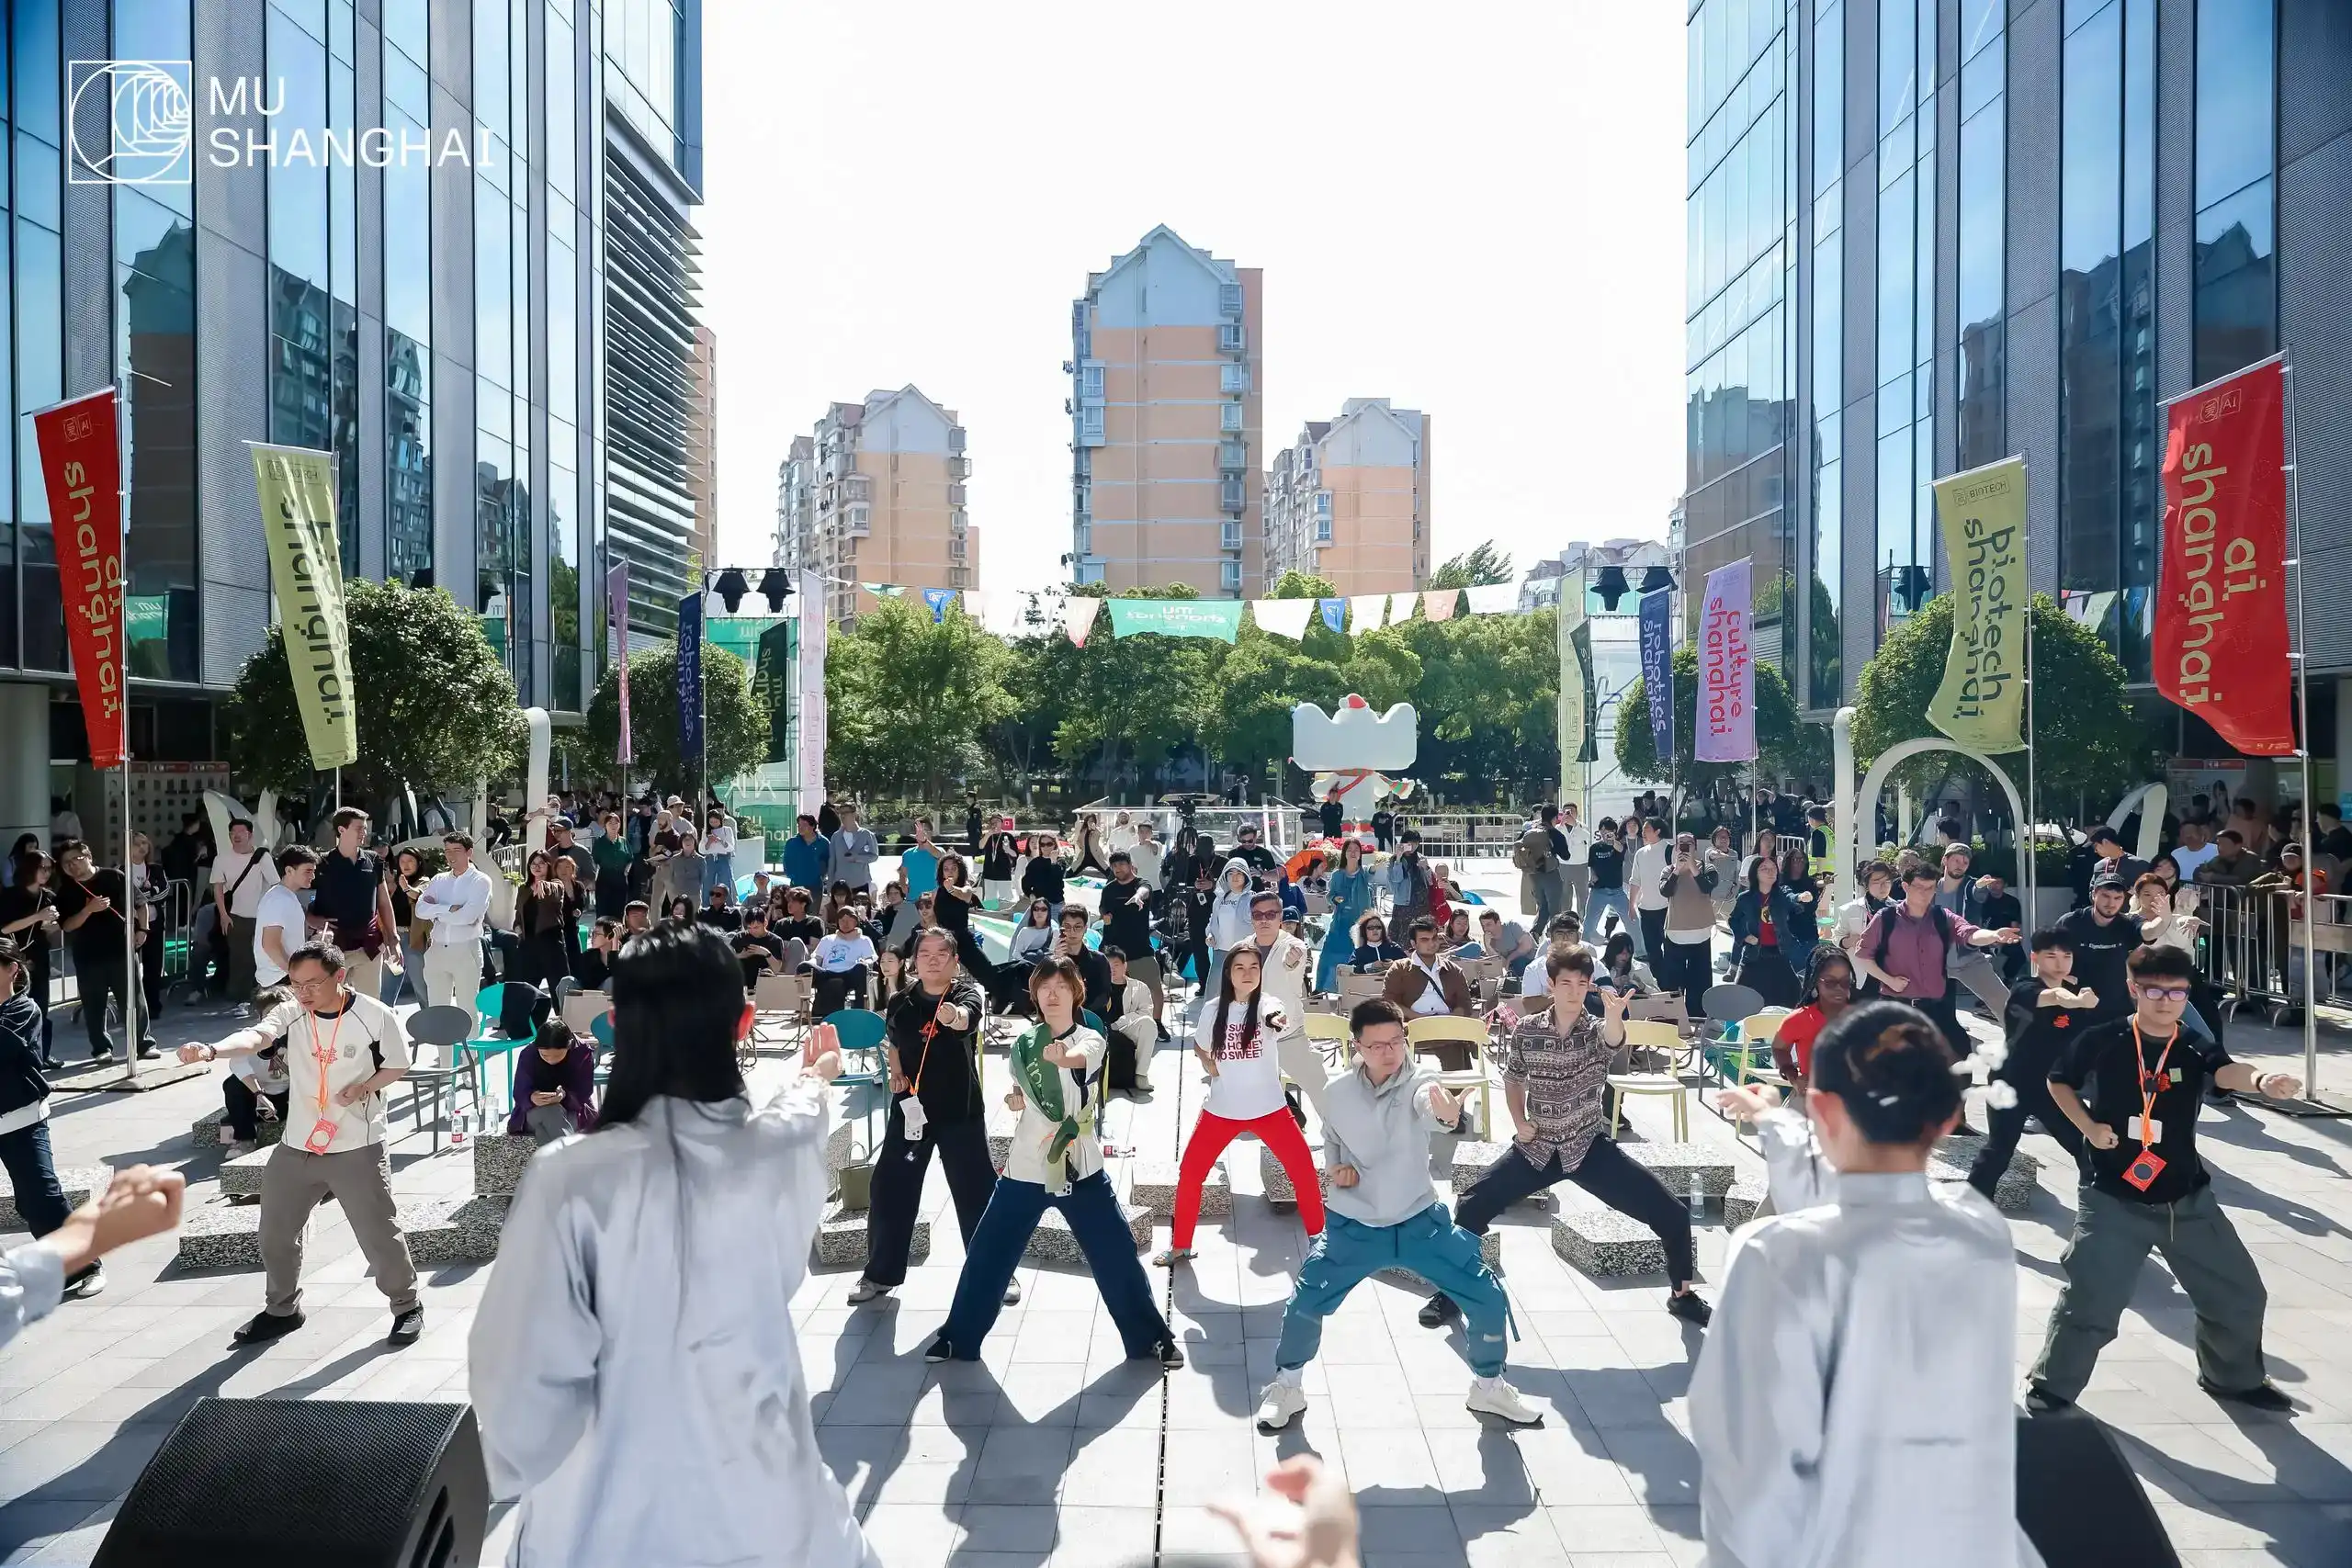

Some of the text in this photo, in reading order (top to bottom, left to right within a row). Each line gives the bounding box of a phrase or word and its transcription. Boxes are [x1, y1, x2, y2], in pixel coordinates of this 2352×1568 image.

[2223, 397, 2236, 410] AI
[1969, 481, 2007, 498] BIOTECH
[64, 461, 123, 719] shanghai
[280, 491, 352, 726] shanghai
[1951, 518, 1994, 720] shanghai
[1983, 525, 2016, 702] biotech
[2178, 443, 2228, 706] shanghai
[2222, 537, 2267, 602] ai
[1654, 623, 1666, 732] robotics
[1704, 597, 1732, 737] shanghai
[1726, 610, 1747, 718] culture
[1227, 1030, 1261, 1042] SYP
[1228, 1048, 1264, 1060] SWEET
